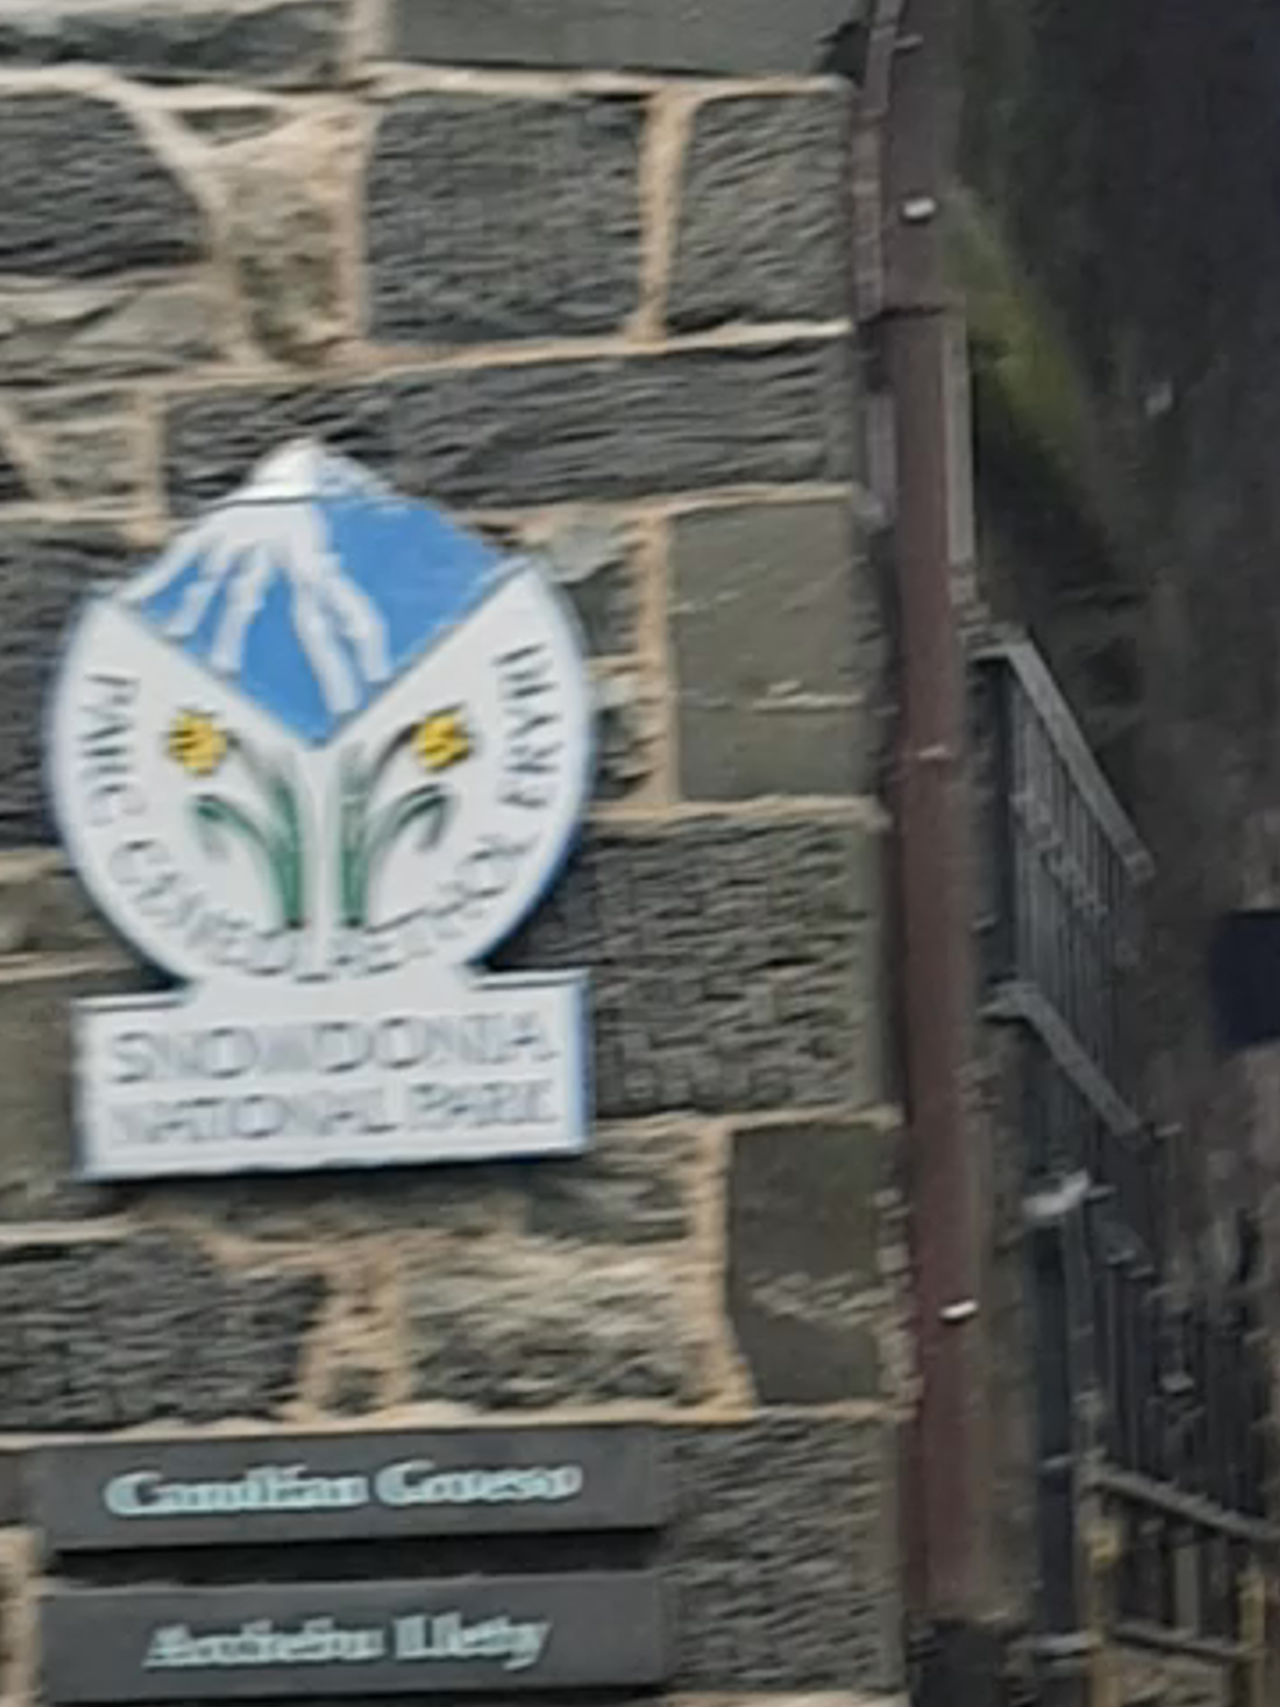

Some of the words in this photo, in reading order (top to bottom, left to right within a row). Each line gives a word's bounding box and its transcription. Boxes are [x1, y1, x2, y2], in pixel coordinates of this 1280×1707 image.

[78, 673, 146, 827] PARC
[111, 1011, 557, 1085] SNOWDONIA
[109, 1094, 401, 1145] NATIONAL
[408, 1079, 560, 1136] PARK
